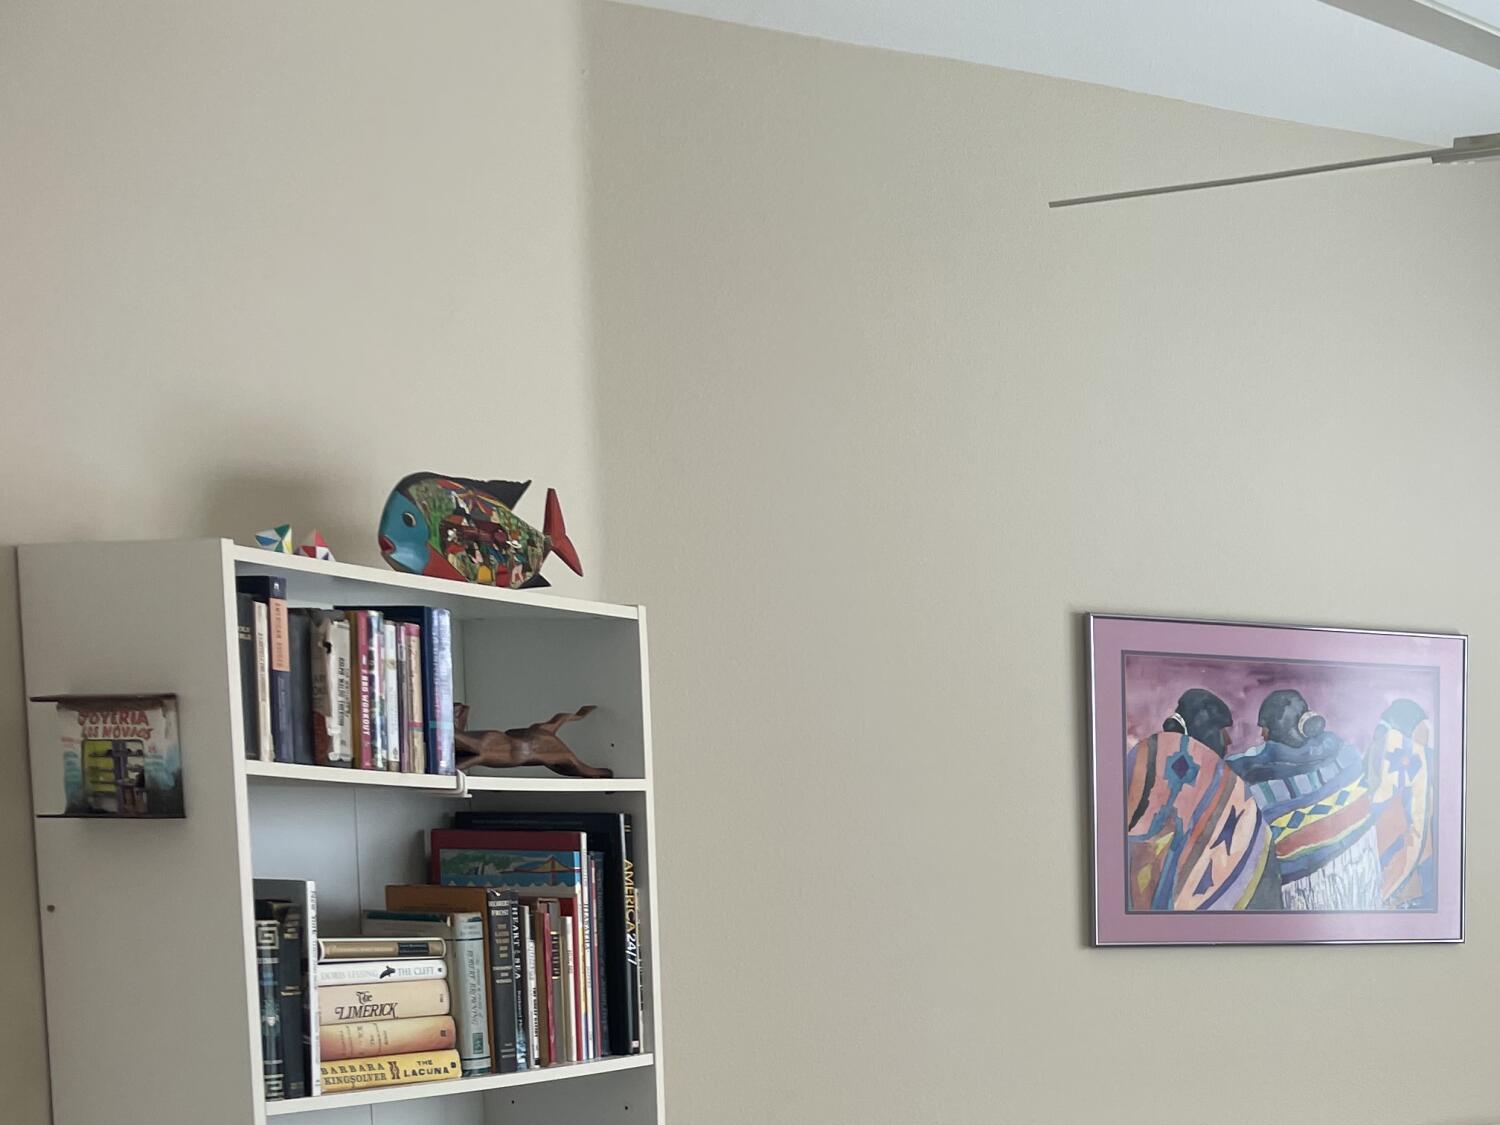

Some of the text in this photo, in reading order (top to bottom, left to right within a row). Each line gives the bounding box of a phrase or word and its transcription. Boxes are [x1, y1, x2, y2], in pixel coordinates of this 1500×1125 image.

[361, 695, 370, 736] WORKOUT
[624, 860, 636, 932] AMERICA
[512, 907, 520, 946] HEART
[397, 967, 411, 977] THE
[355, 991, 373, 1004] The
[335, 1002, 399, 1020] LIMERICK
[320, 1062, 385, 1075] BARBARA
[404, 1066, 450, 1078] LACUNA
[324, 1072, 387, 1088] KINGSOLVER
